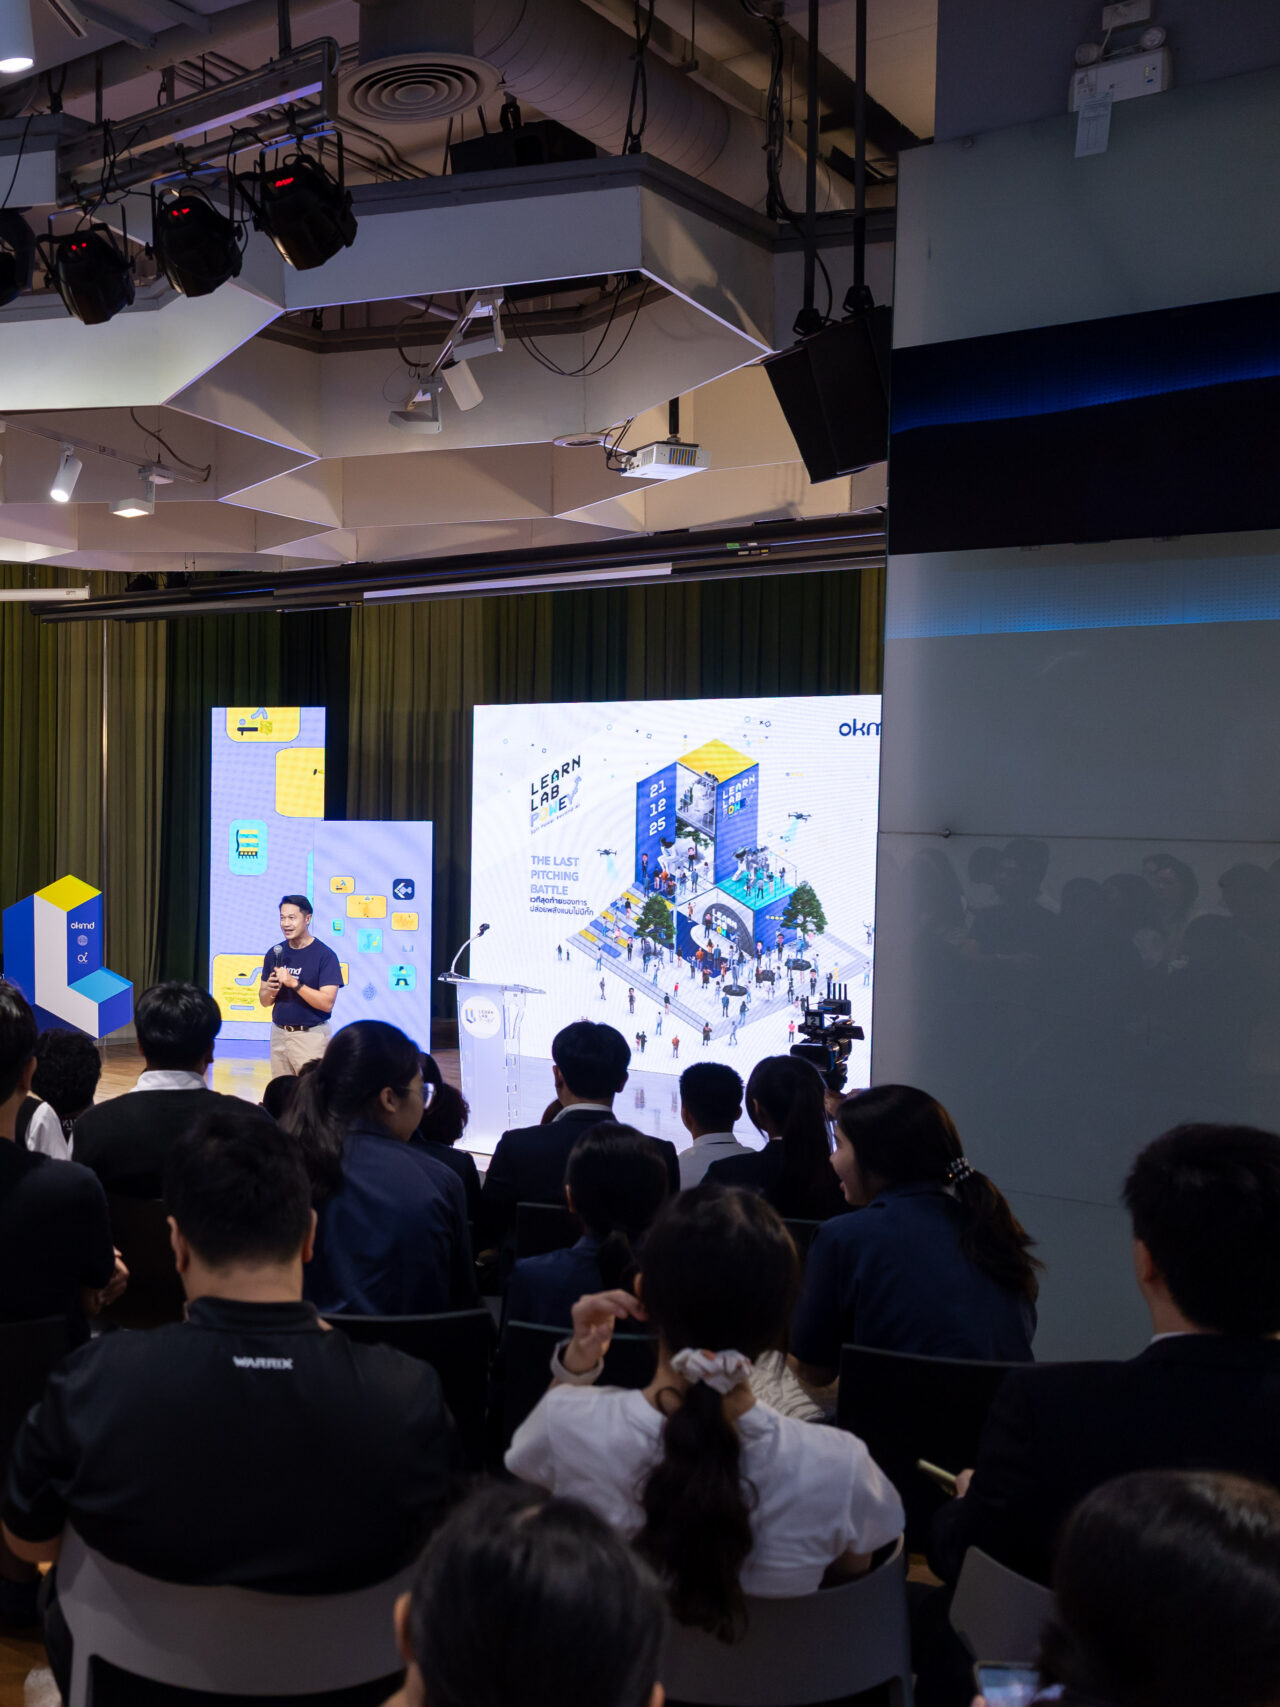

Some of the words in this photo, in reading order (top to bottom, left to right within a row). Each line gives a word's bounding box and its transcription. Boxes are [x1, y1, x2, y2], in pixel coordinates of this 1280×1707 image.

[839, 718, 882, 736] okm
[531, 755, 581, 796] LEARN
[531, 784, 559, 812] LAB
[650, 780, 666, 798] 21
[650, 798, 666, 817] 12
[649, 817, 666, 836] 25
[531, 855, 551, 866] THE
[553, 856, 579, 867] LAST
[531, 869, 579, 881] PITCHING
[530, 884, 569, 895] BATTLE
[810, 1016, 816, 1026] 2
[232, 1355, 294, 1370] WARRIX
